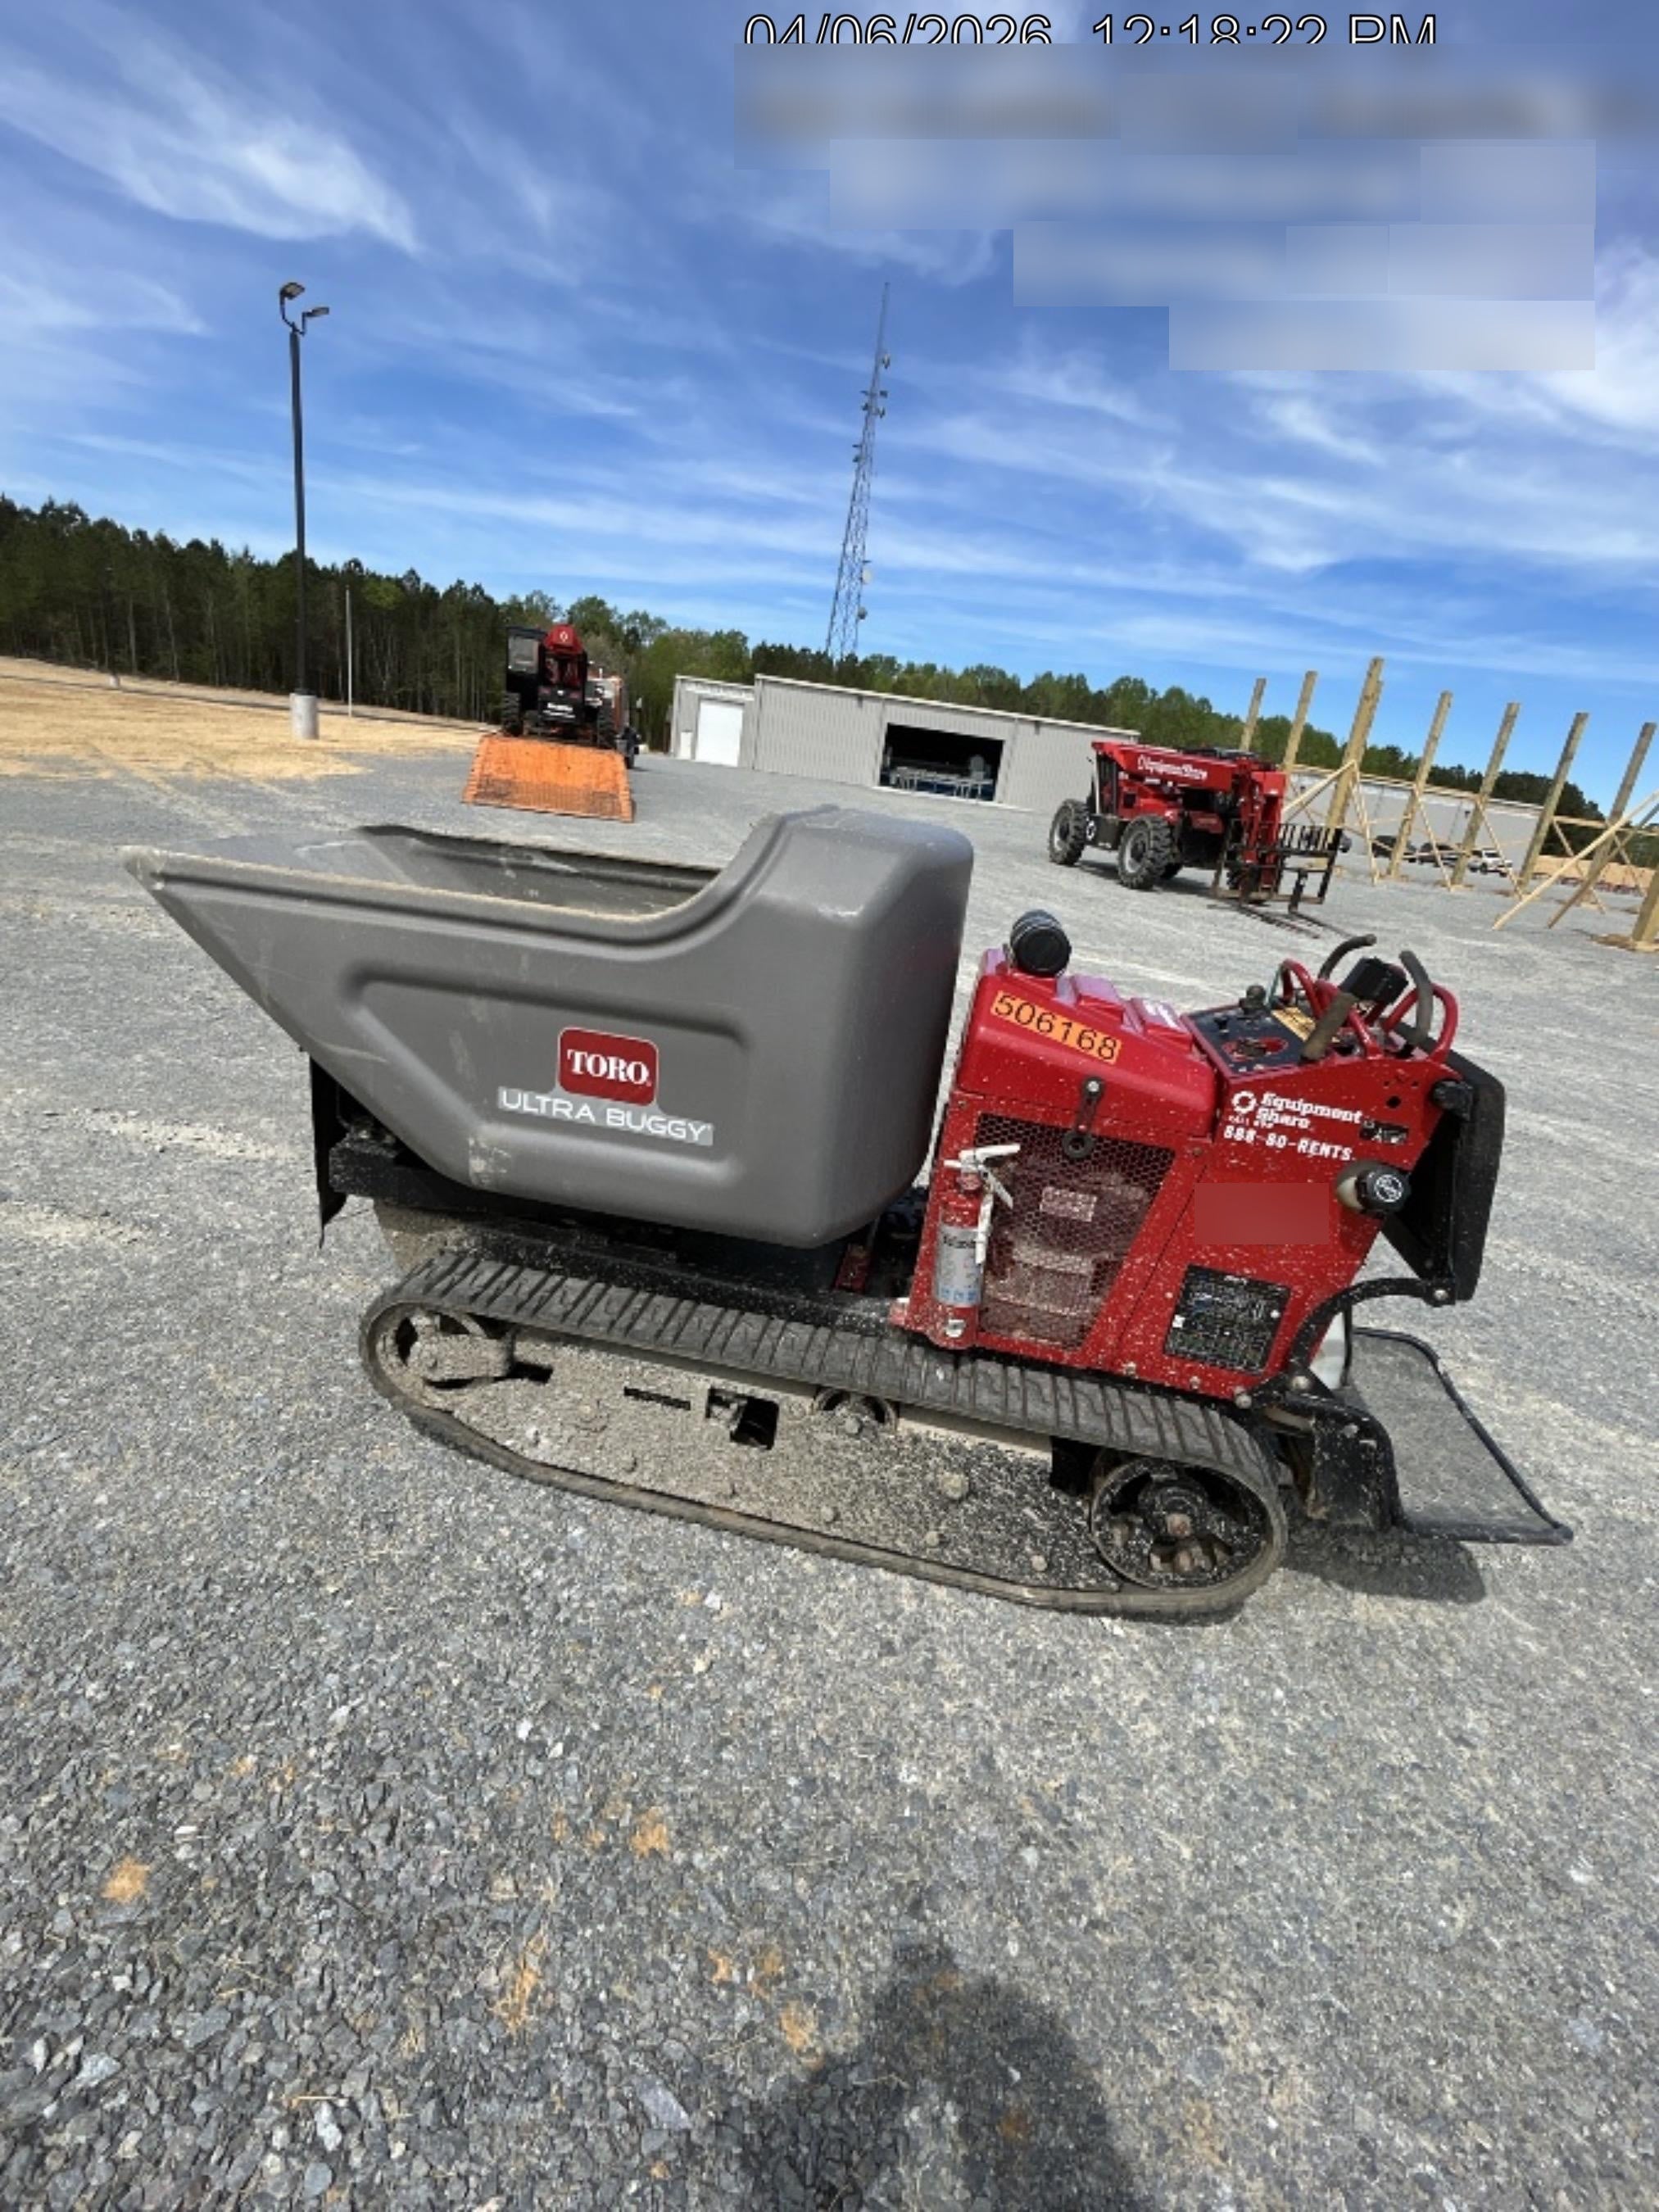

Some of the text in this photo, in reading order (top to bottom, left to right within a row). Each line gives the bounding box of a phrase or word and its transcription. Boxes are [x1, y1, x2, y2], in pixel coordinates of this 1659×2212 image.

[995, 995, 1117, 1059] 506168
[567, 1049, 651, 1086] TORO
[501, 1090, 707, 1141] ULTRA BUGGY
[1255, 1106, 1311, 1130] Share
[1261, 1091, 1363, 1124] Equipment
